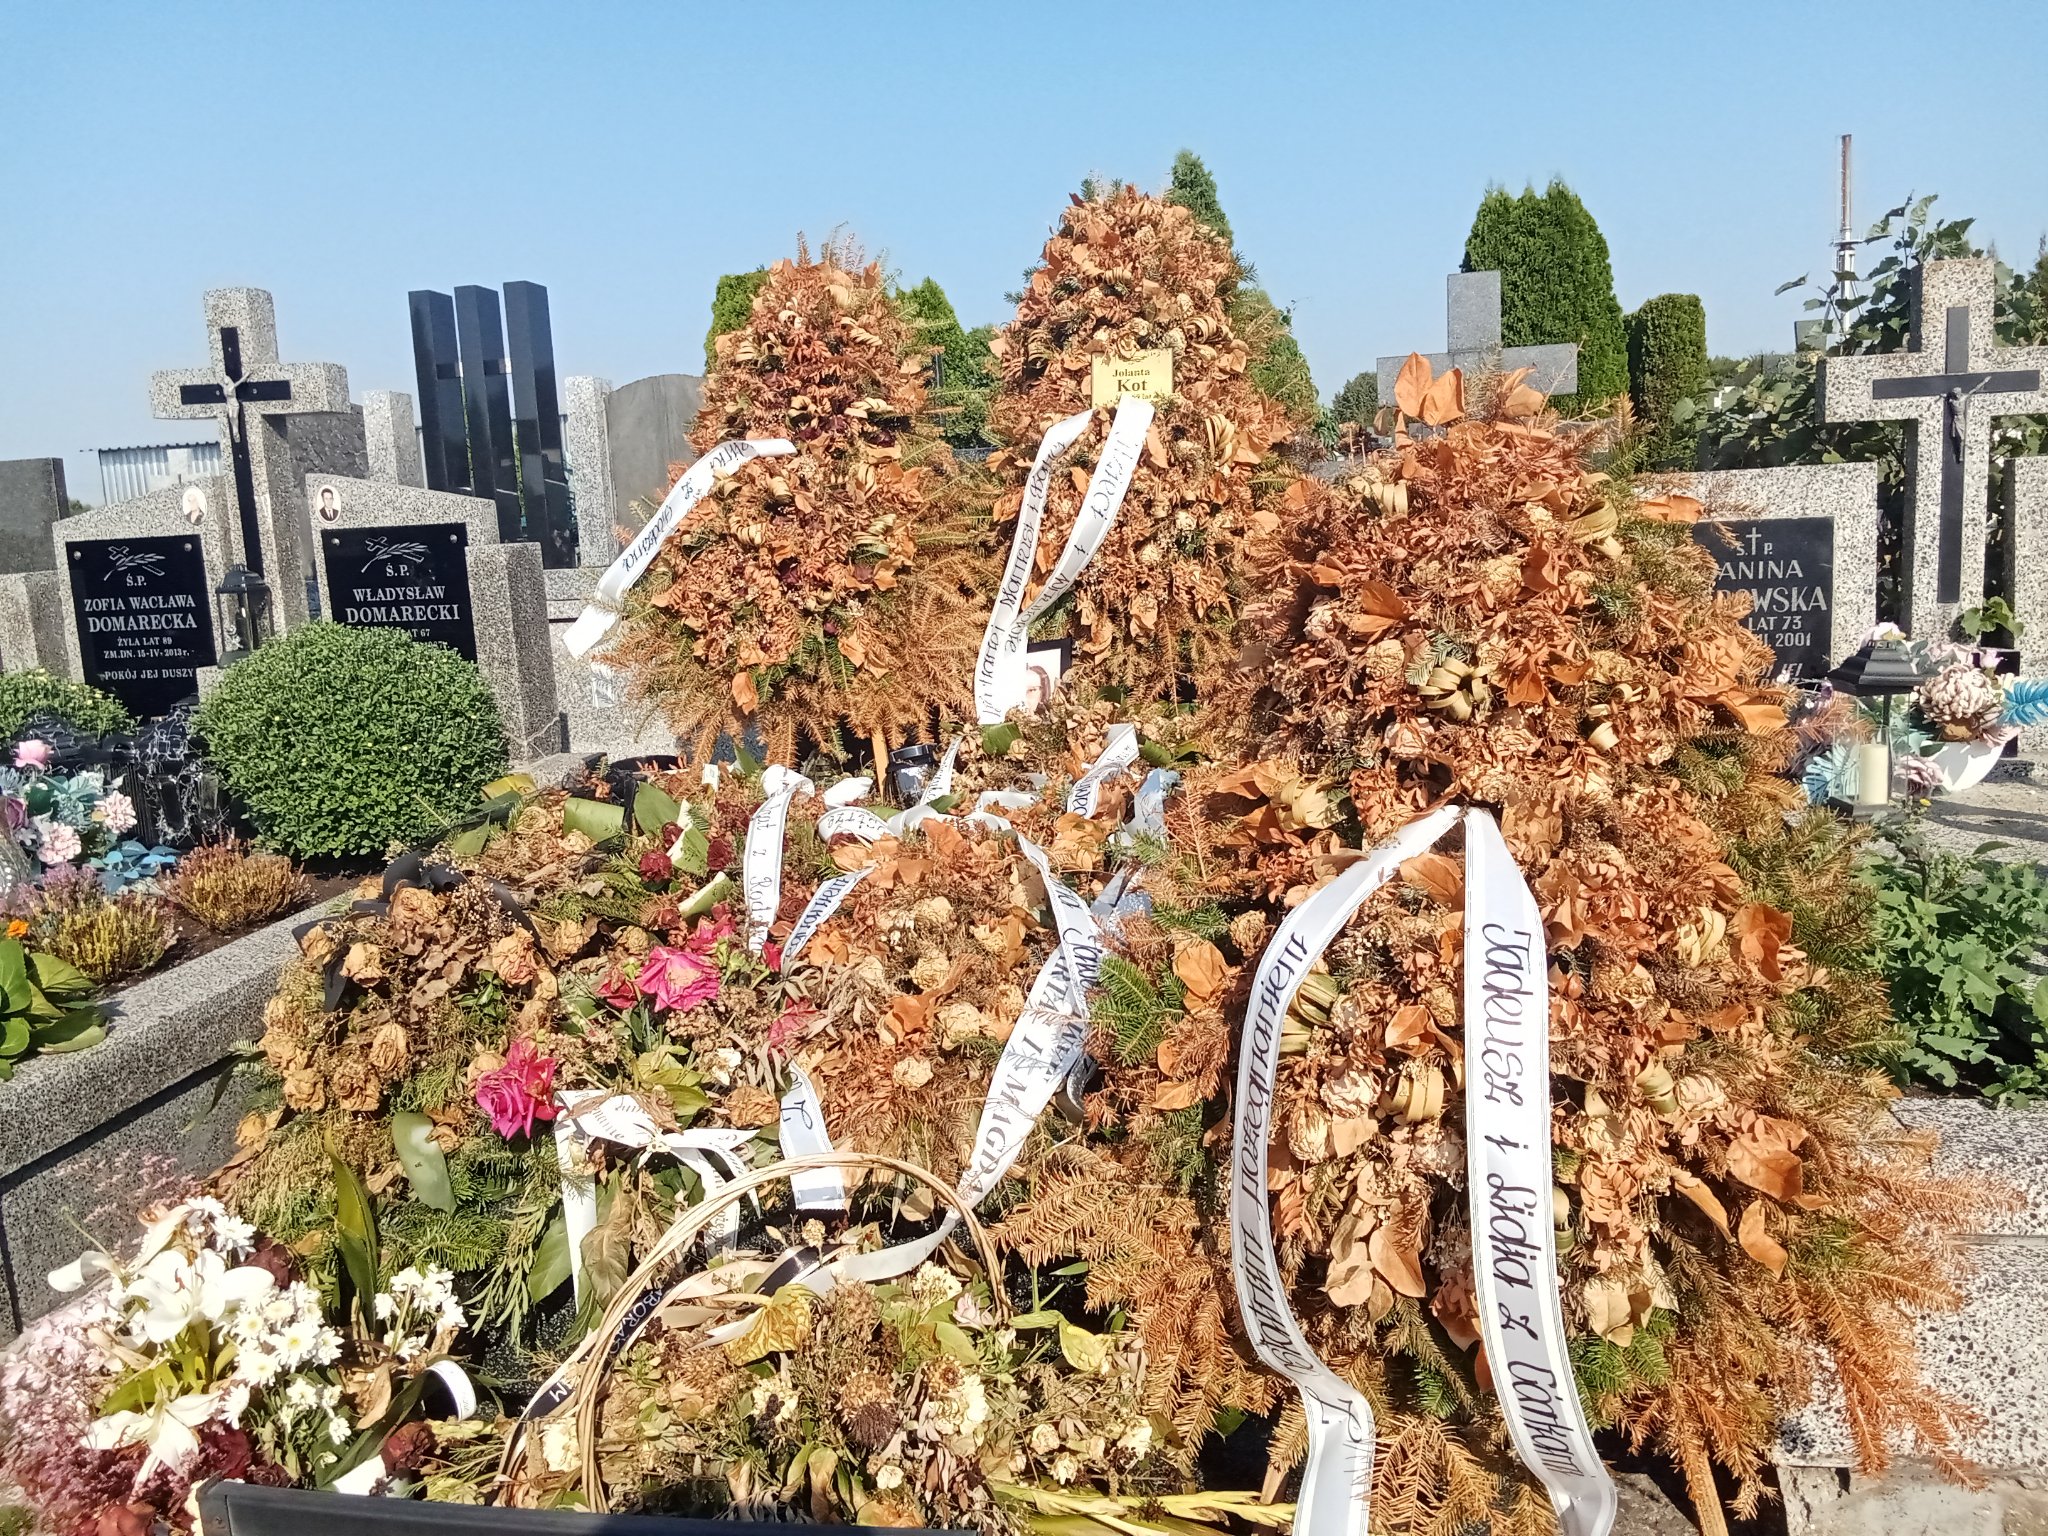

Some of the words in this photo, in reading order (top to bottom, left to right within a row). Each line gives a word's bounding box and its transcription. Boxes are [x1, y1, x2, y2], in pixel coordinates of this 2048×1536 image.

[1112, 369, 1151, 378] Jolanta
[1117, 379, 1148, 392] Kot
[1719, 559, 1804, 580] ANINA
[353, 585, 446, 602] WŁADYSŁAW
[84, 597, 125, 612] ZOFIA
[129, 594, 196, 609] WACŁAWA
[345, 604, 460, 623] DOMARECKI
[88, 613, 197, 632] DOMARECKA
[1748, 616, 1778, 631] LAT
[1782, 615, 1802, 630] 73
[420, 628, 431, 637] 67
[1775, 632, 1811, 647] 2001
[143, 637, 160, 646] LAT
[162, 637, 173, 645] 89
[104, 668, 137, 680] POKÓJ
[141, 669, 159, 679] JEJ
[162, 668, 194, 678] DUSZY
[1482, 922, 1531, 1108] Tadeusz
[1486, 1136, 1528, 1153] i
[1486, 1174, 1541, 1290] Lidia
[1497, 1301, 1538, 1341] z
